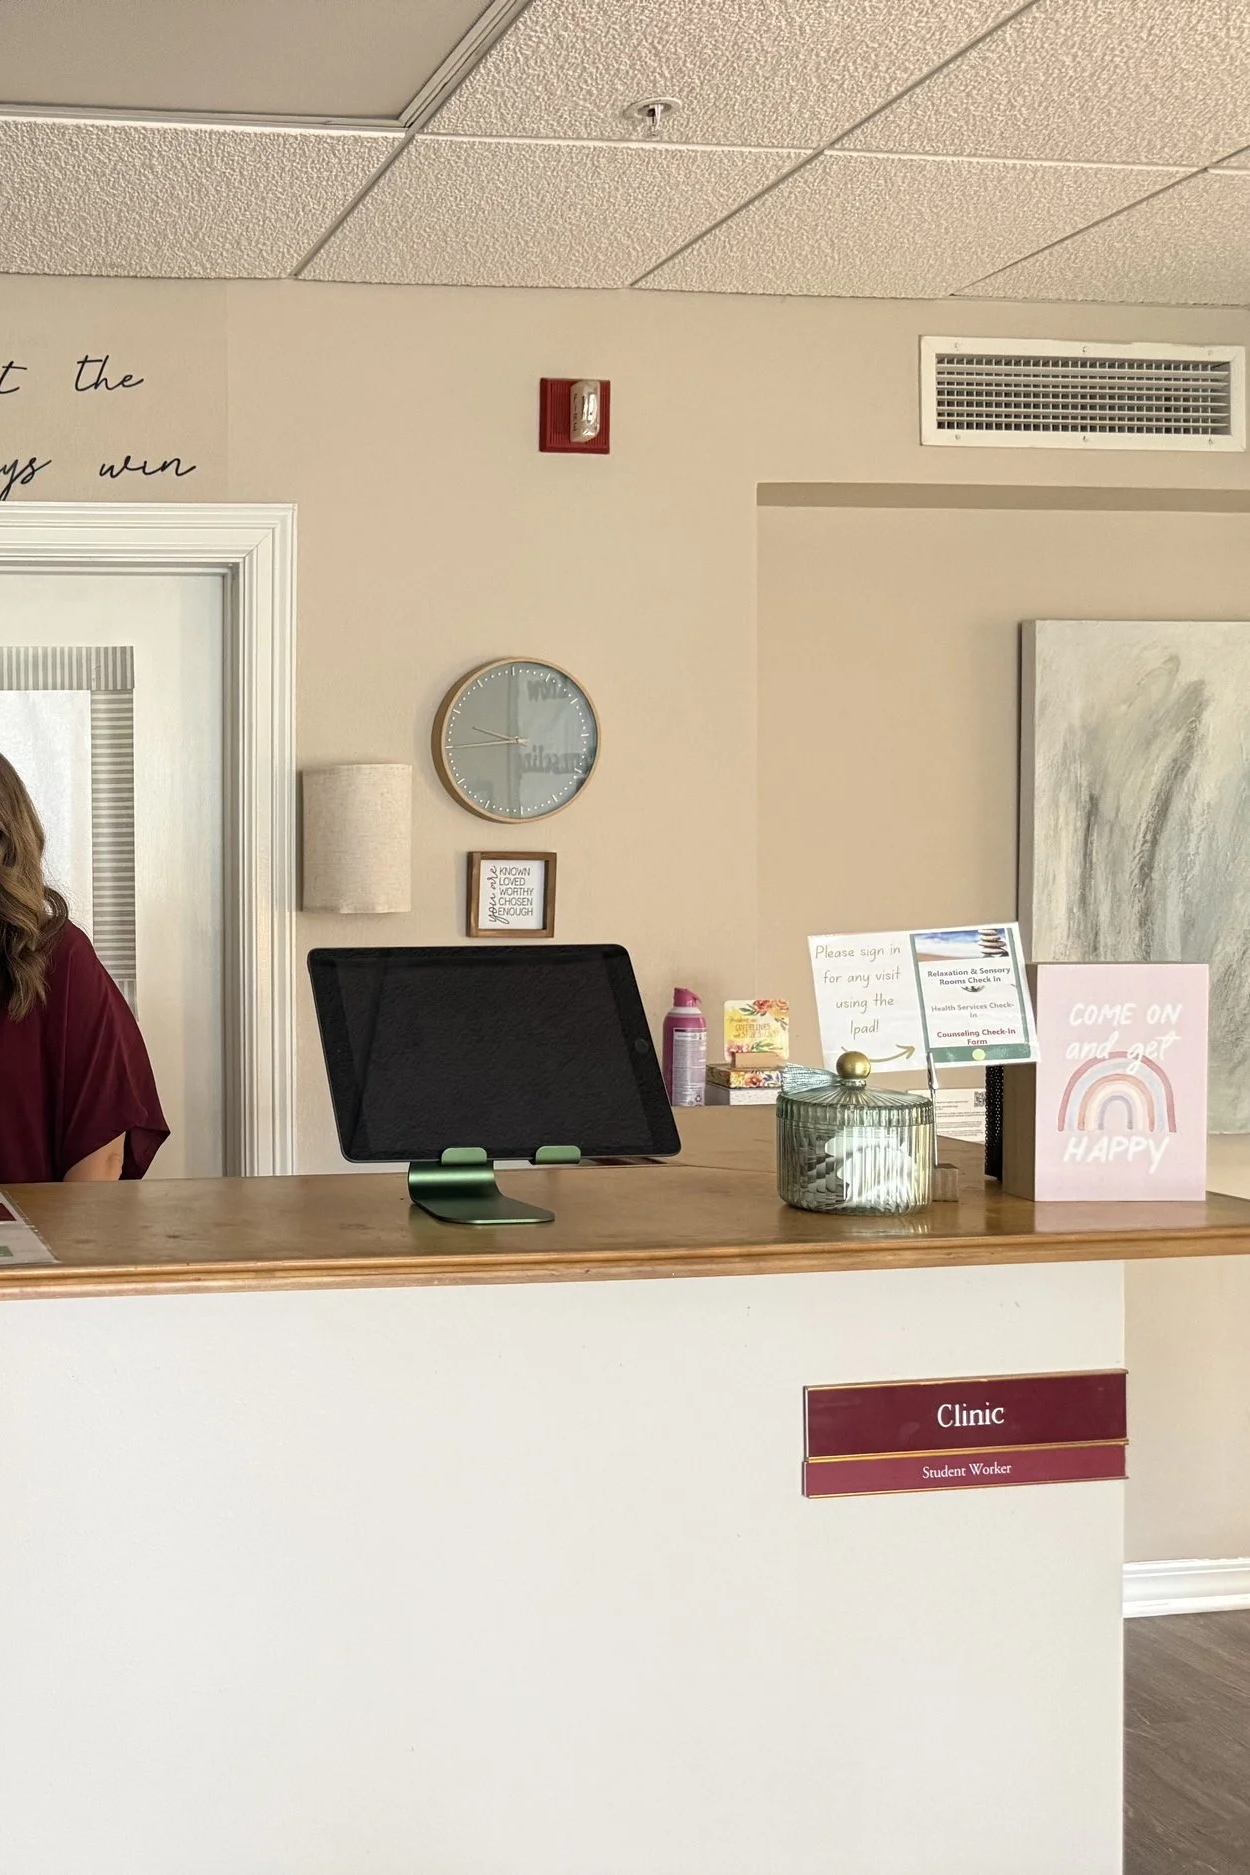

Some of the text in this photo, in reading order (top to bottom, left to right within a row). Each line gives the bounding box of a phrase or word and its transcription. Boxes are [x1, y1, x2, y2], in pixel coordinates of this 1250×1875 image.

[74, 355, 144, 392] the
[98, 454, 197, 478] win
[499, 867, 530, 876] KNOWN
[498, 877, 526, 886] LOVED
[499, 887, 534, 896] WORTHY
[498, 897, 533, 906] CHOSEN
[498, 907, 533, 916] ENOUGH
[815, 944, 901, 963] Please sign in
[823, 965, 901, 988] for any visit
[927, 969, 968, 977] Relaxation
[979, 967, 1011, 975] Sensory
[967, 976, 991, 984] Check
[836, 993, 894, 1014] using the
[931, 1004, 955, 1012] Health
[957, 1003, 987, 1011] Services
[1069, 1002, 1183, 1026] COME ON
[937, 1028, 1016, 1038] Counseling Check-In
[1065, 1030, 1182, 1075] and get
[1063, 1135, 1170, 1174] HAPPY
[937, 1402, 1005, 1428] Clinic
[922, 1462, 1012, 1479] Student Worker
